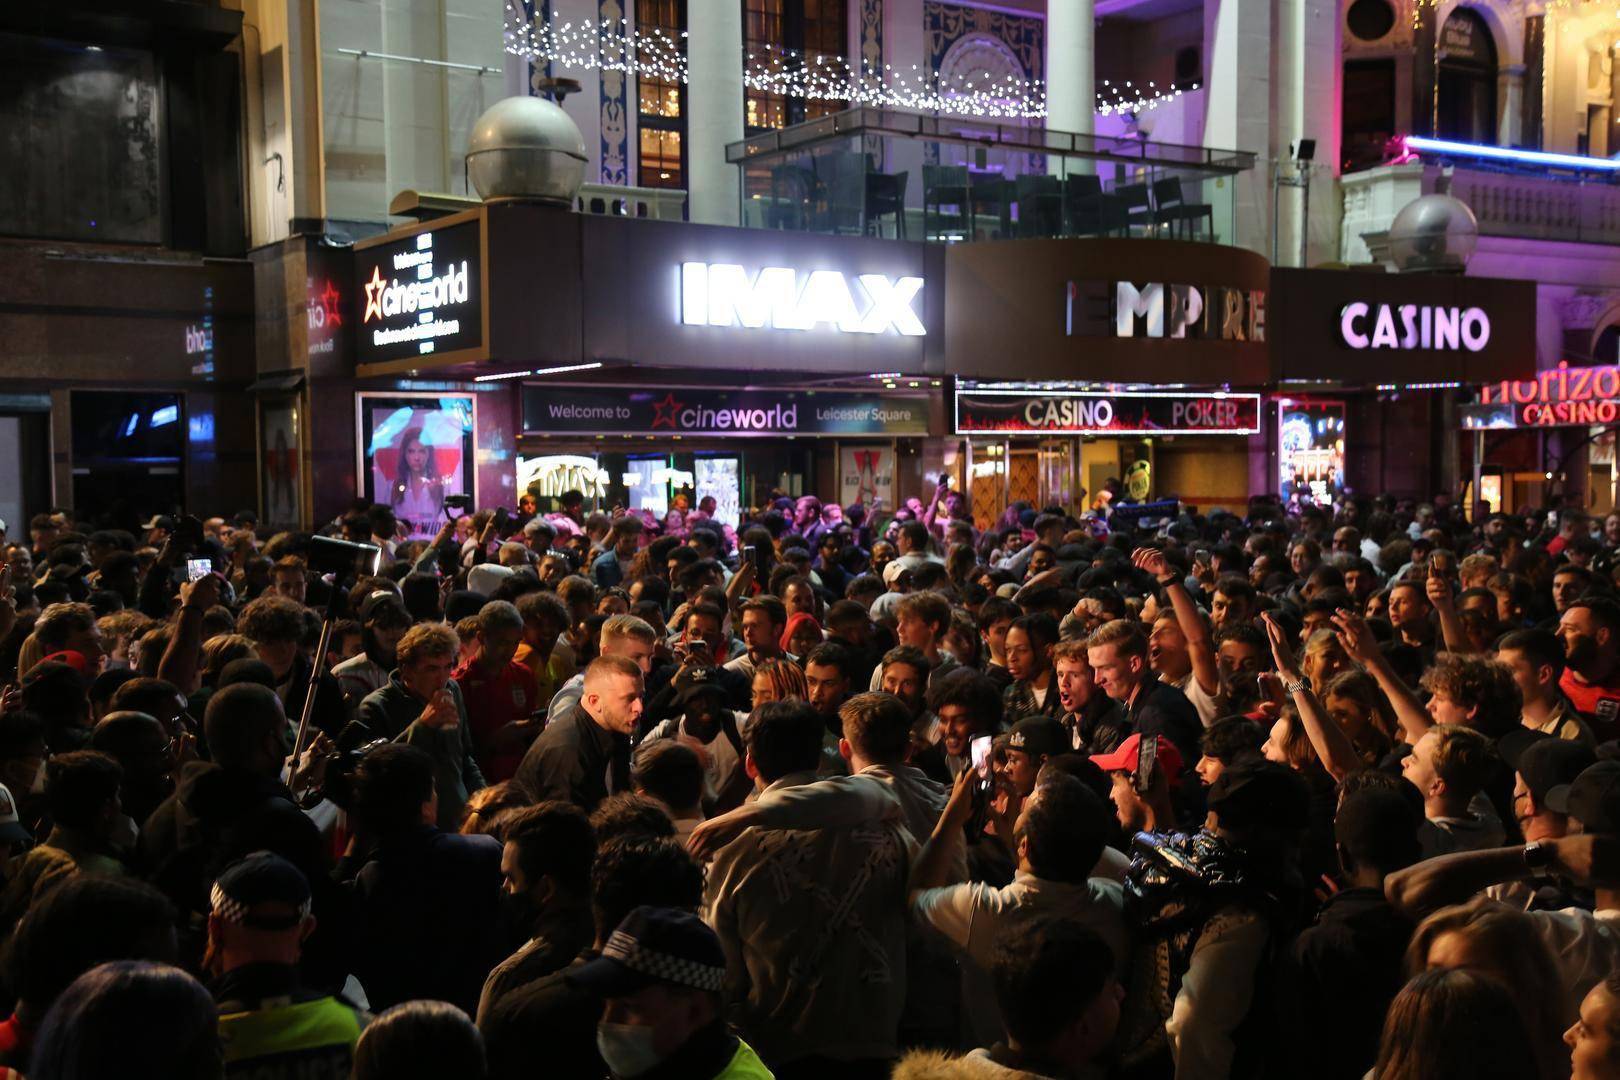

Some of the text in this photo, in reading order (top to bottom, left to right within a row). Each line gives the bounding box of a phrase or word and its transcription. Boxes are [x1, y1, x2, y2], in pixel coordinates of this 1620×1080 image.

[383, 261, 468, 317] cineorld
[680, 262, 927, 337] IMAX
[1066, 280, 1265, 342] EMPIRE
[1341, 302, 1490, 351] CASINO
[549, 403, 911, 429] Welcome to cineworld Leicester Square
[1025, 400, 1237, 426] CASINO POKER
[1523, 401, 1617, 426] CASINO
